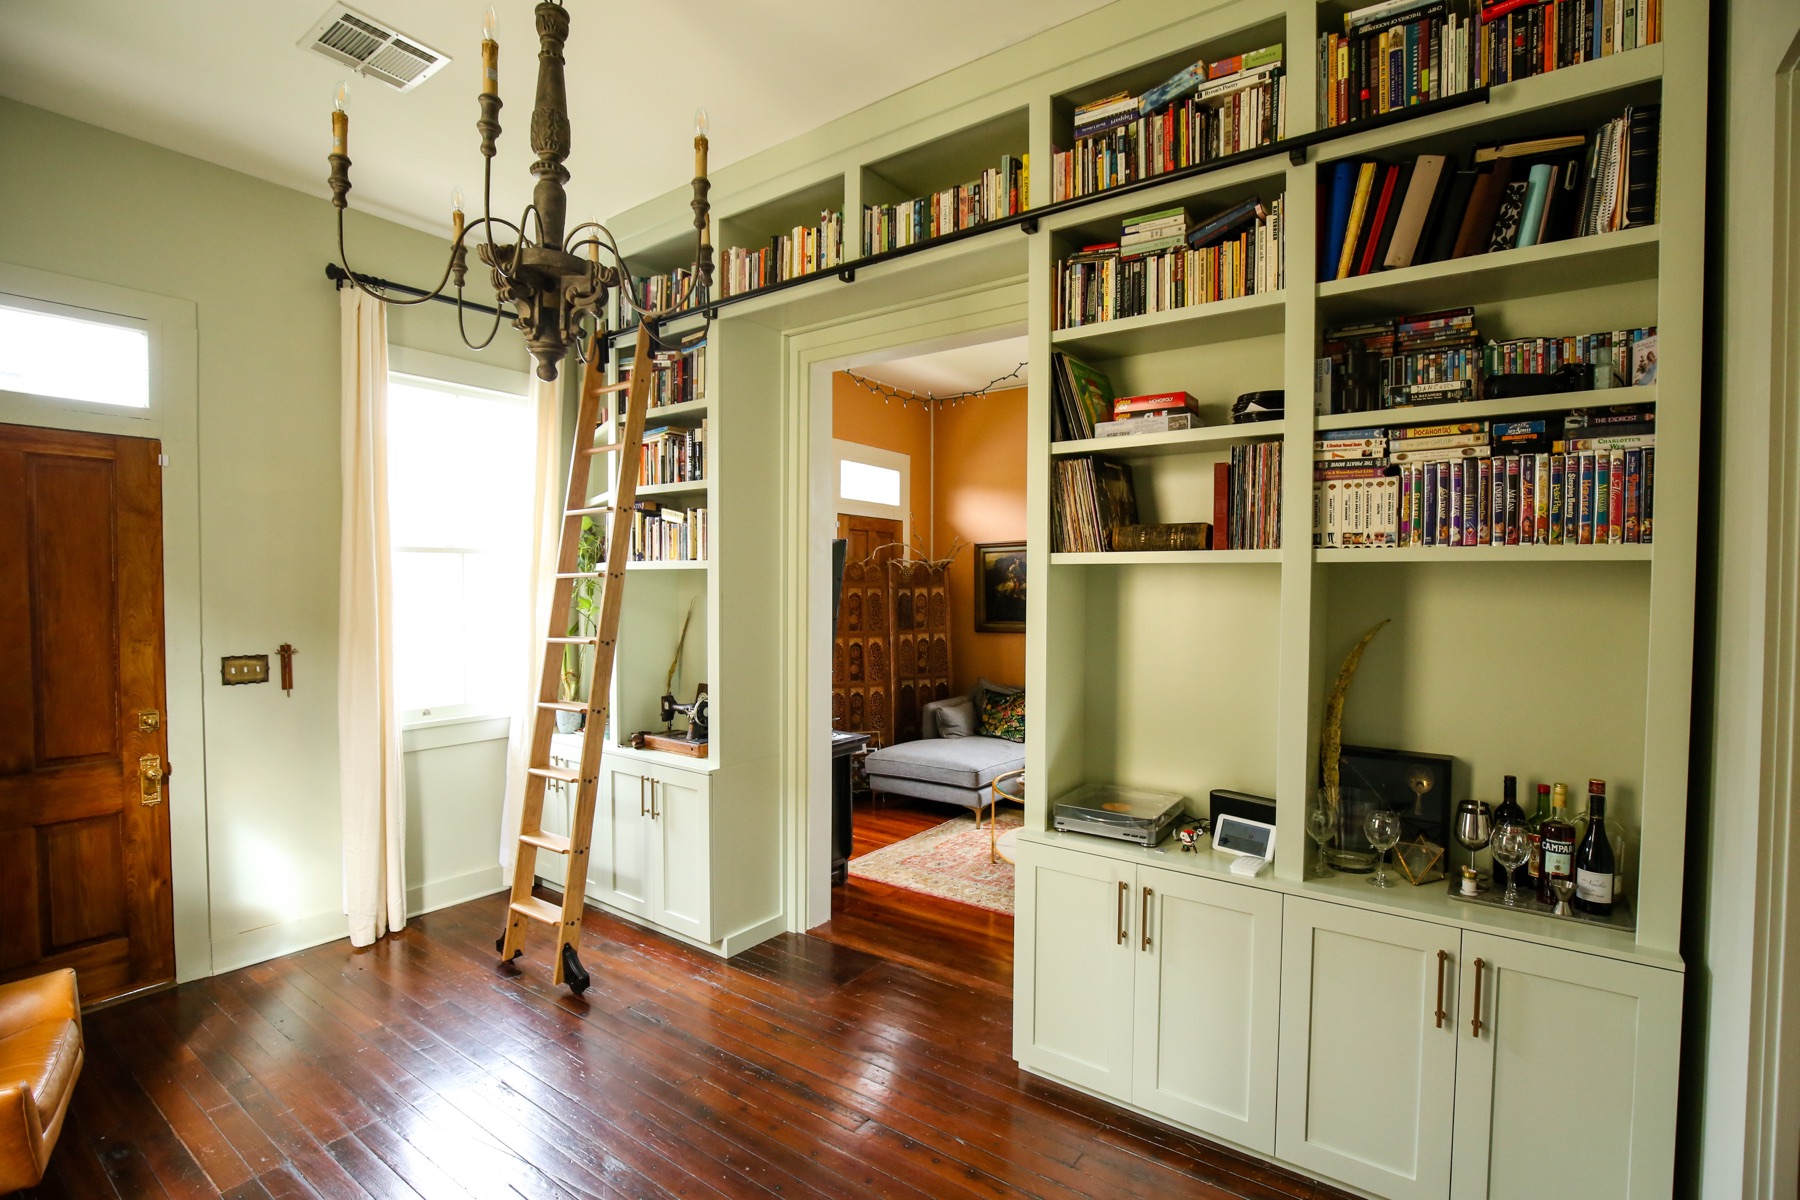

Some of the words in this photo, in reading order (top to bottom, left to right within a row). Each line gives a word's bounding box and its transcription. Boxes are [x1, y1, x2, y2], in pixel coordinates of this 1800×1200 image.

[1398, 12, 1421, 22] THEORIES
[1204, 86, 1221, 96] Byron's
[1222, 82, 1238, 92] Poetry
[1414, 426, 1452, 436] POCAHONTAS
[1567, 473, 1575, 497] Sleeping
[1464, 494, 1476, 520] FANTASIA
[1494, 481, 1503, 513] CINDERELLA
[1567, 498, 1575, 518] Beauty
